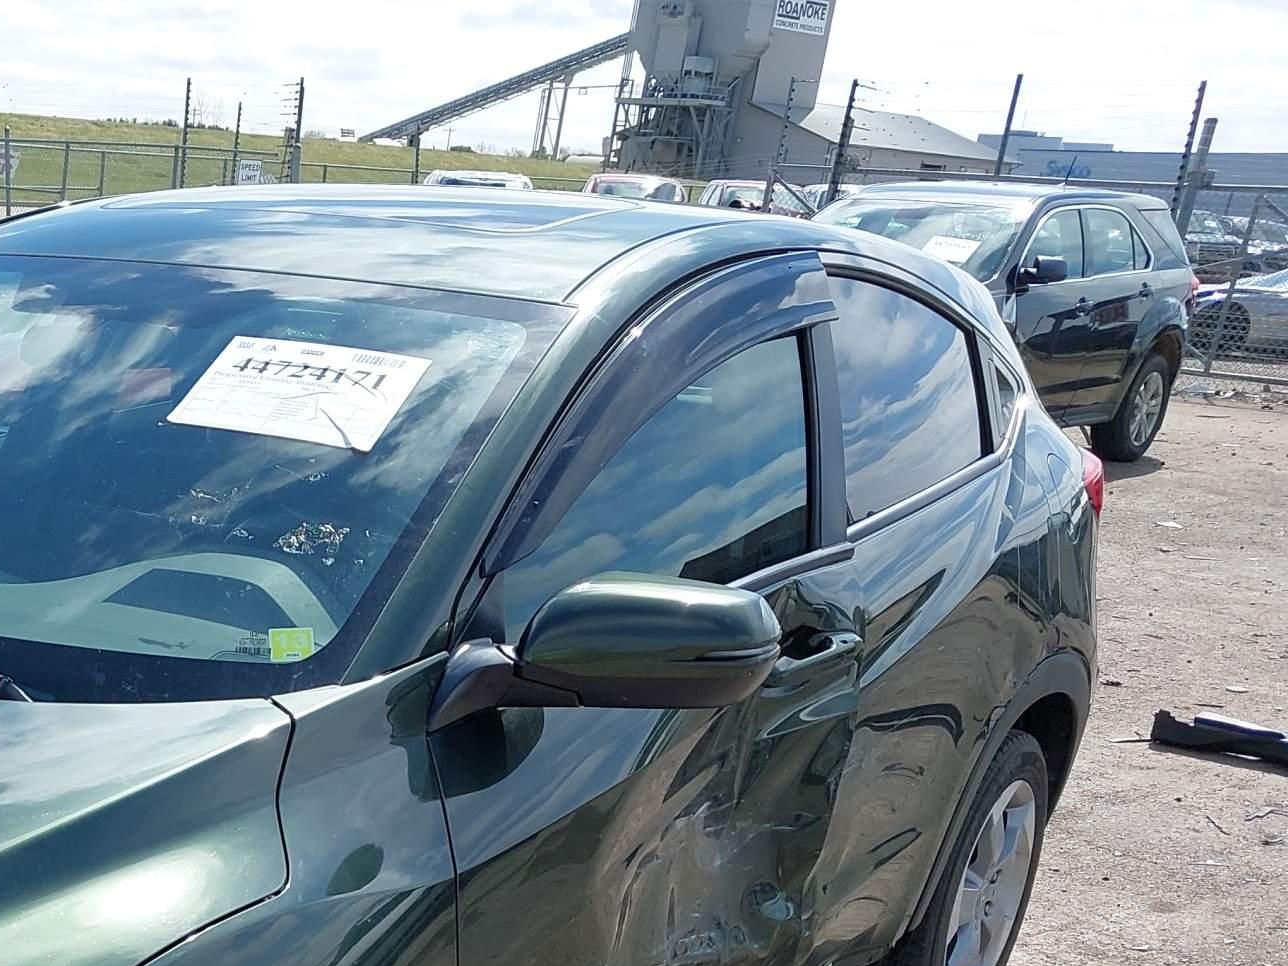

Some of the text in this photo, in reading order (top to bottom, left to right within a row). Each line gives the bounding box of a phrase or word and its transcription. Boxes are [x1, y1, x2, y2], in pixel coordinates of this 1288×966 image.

[778, 0, 827, 20] ROANOKE
[775, 19, 823, 33] CONCRETE PRODUCTS
[241, 163, 260, 171] SPEED
[241, 174, 257, 182] LIMIT
[232, 357, 387, 389] 44724171
